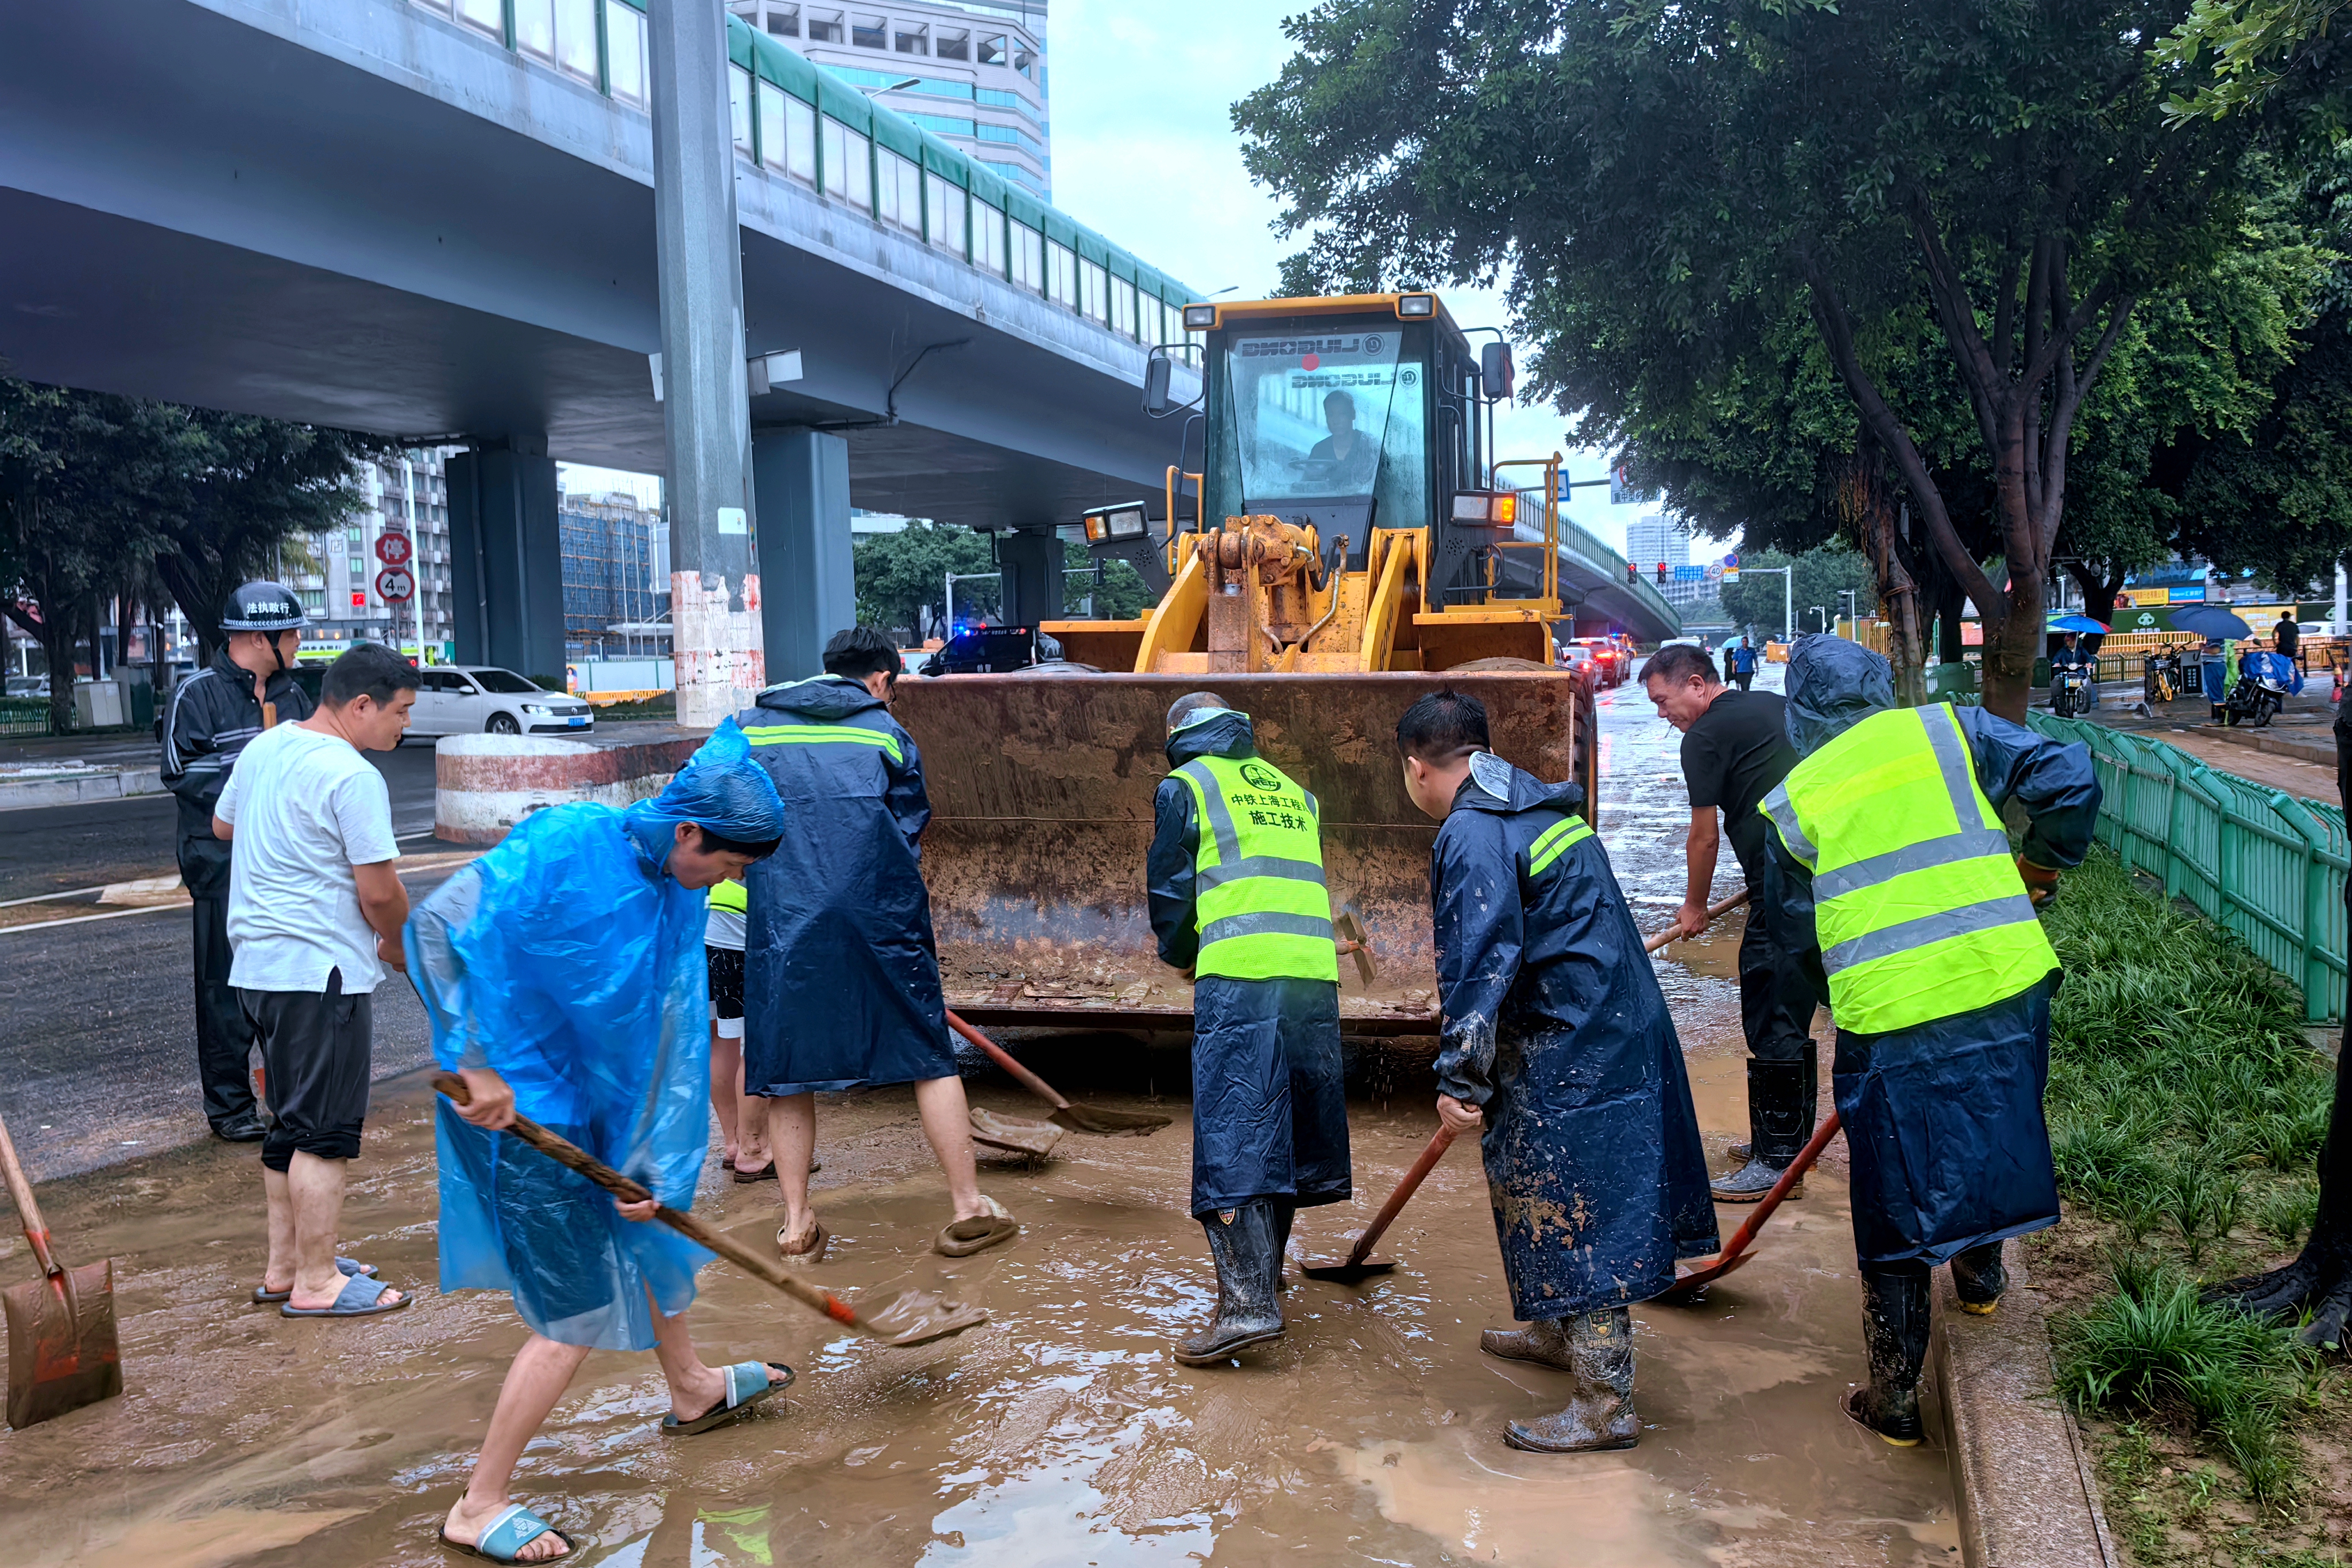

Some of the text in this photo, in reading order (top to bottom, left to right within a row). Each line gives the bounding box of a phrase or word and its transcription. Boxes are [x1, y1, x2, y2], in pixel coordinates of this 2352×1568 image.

[383, 539, 405, 559] 停
[1711, 567, 1721, 575] 40
[1248, 810, 1307, 832] 施工技术
